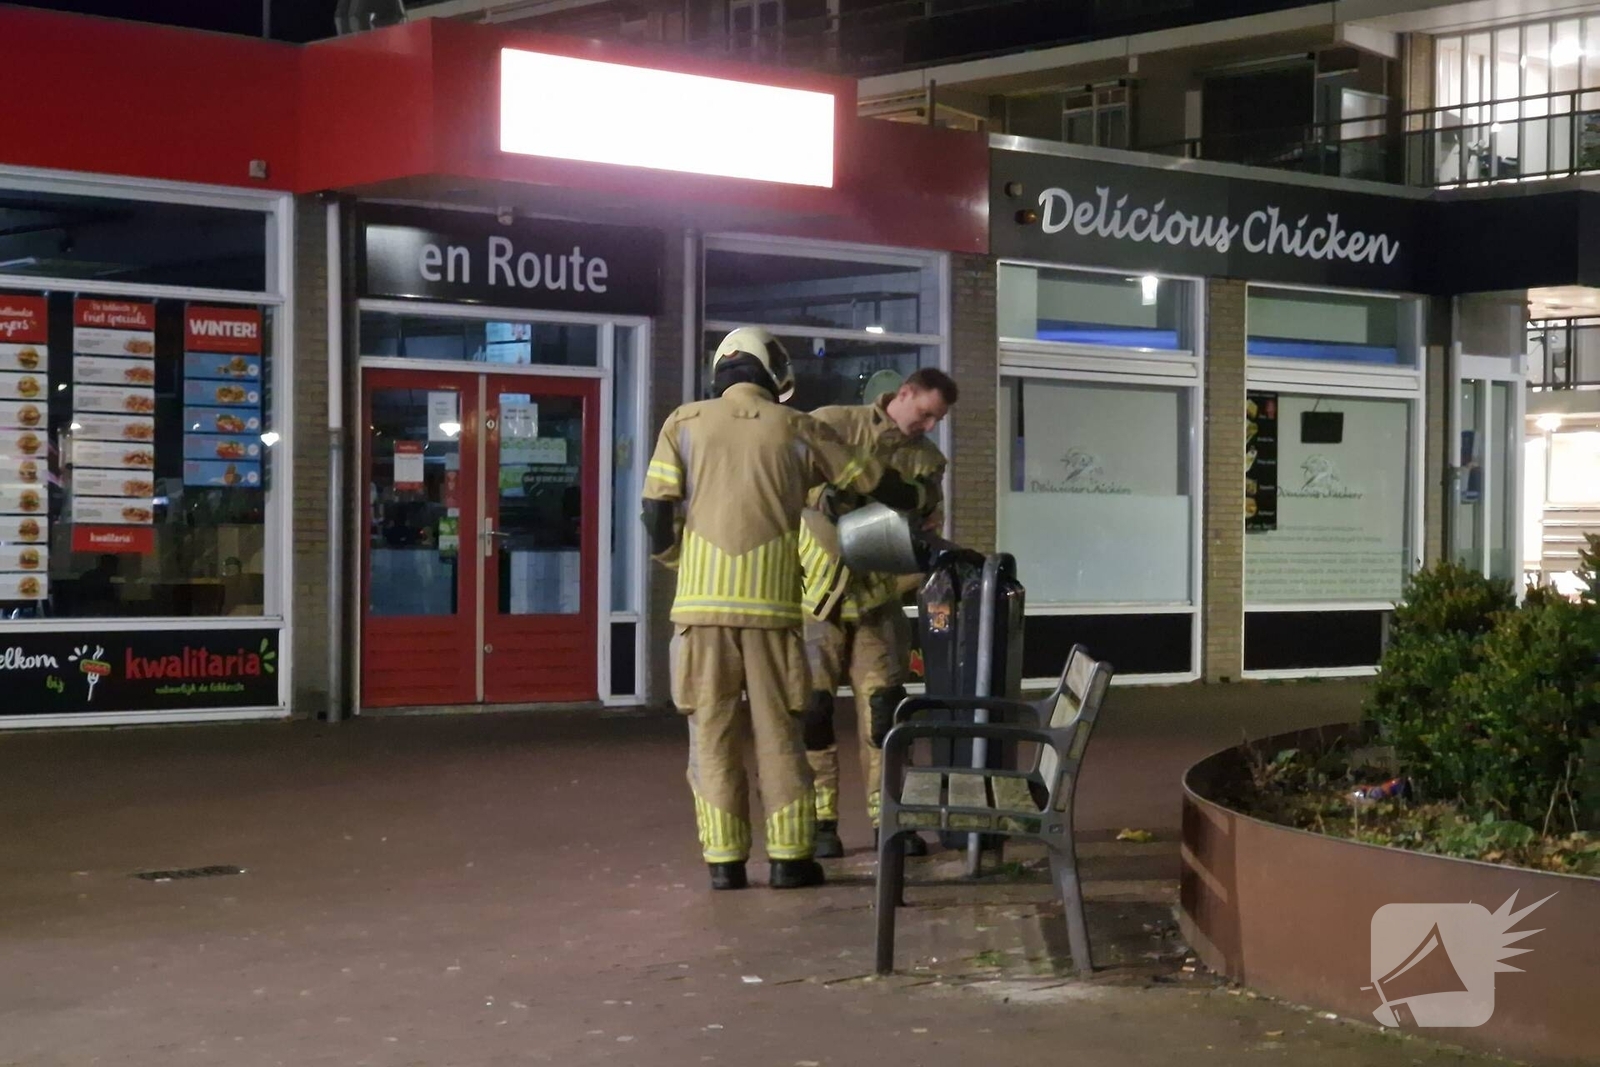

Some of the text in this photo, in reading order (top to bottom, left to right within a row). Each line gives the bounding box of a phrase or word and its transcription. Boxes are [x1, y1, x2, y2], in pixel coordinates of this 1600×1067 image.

[1038, 186, 1399, 265] Delicious Chicken
[418, 235, 609, 293] en Route
[189, 318, 258, 338] WINTER!
[125, 645, 261, 680] kwalitaria
